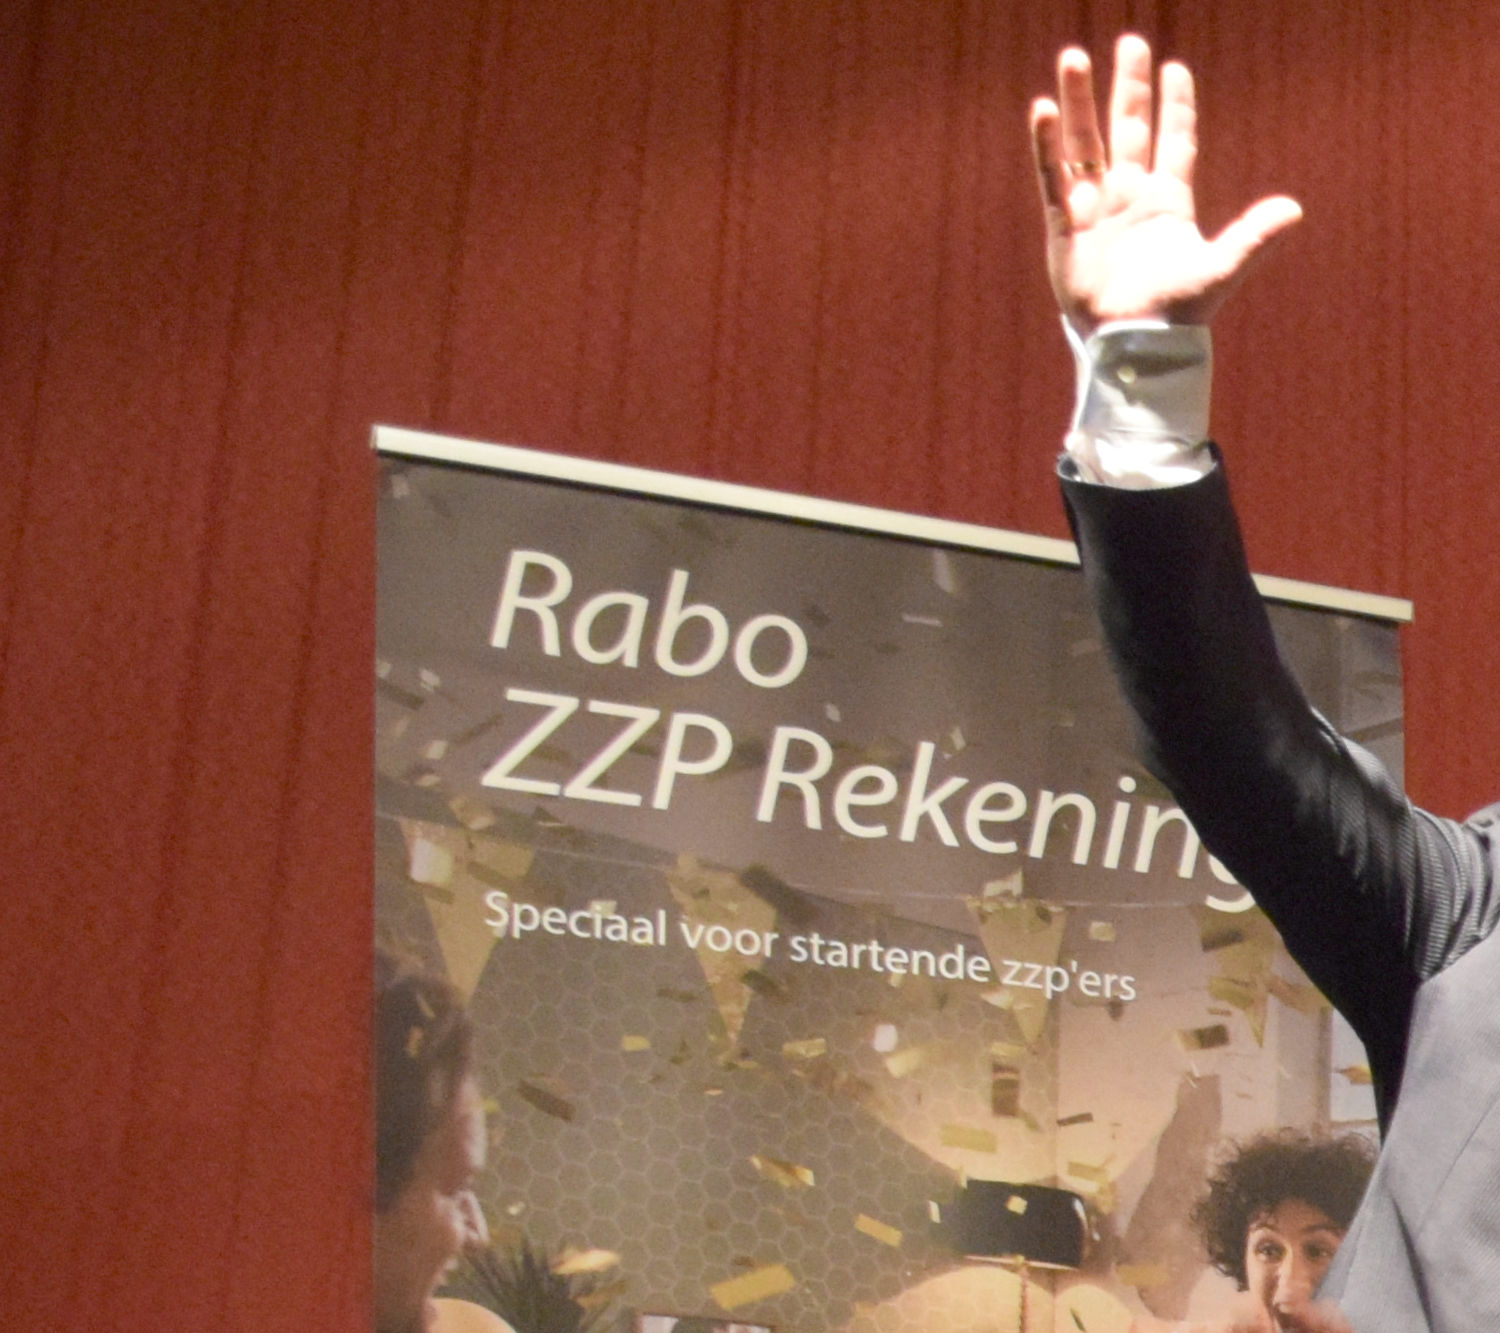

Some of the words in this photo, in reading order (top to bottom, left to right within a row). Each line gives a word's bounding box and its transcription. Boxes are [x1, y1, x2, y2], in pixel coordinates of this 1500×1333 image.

[490, 550, 808, 688] Rabo
[481, 688, 734, 811] ZZP
[484, 891, 666, 945] Speciaal
[680, 917, 778, 957] voor
[790, 931, 990, 984] startende
[1002, 959, 1136, 1003] zzp'ers
